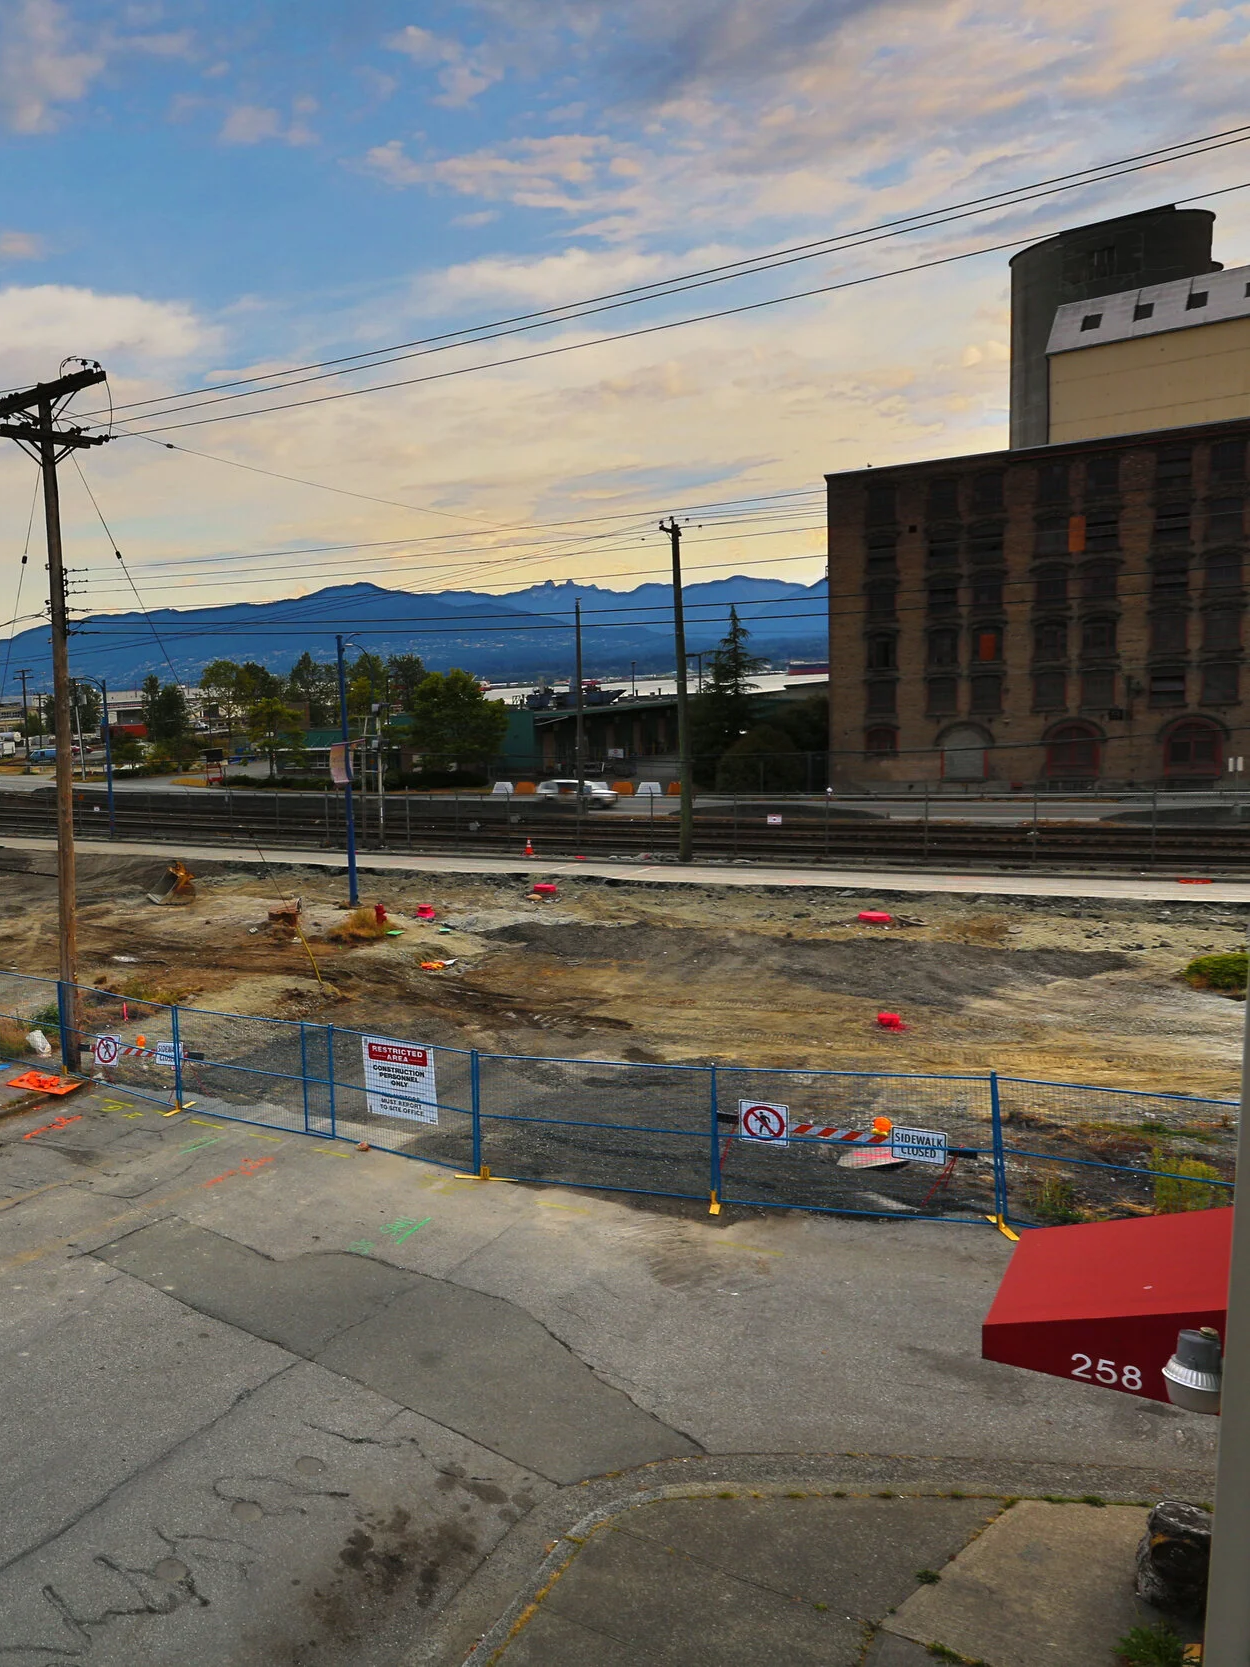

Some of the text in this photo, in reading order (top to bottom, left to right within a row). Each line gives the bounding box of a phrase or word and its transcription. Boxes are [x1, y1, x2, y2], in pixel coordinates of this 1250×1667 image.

[371, 1045, 423, 1058] RESTRICTED
[386, 1054, 409, 1063] AREA
[372, 1064, 425, 1078] CONSTRUCTION
[379, 1071, 419, 1083] PERSONNEL
[390, 1080, 409, 1088] ONLY
[381, 1097, 422, 1110] MUST REPORT
[389, 1105, 402, 1113] SITE
[402, 1107, 424, 1117] OFFICE
[894, 1132, 944, 1148] SIDEWALK
[900, 1146, 937, 1159] CLOSED
[1071, 1353, 1143, 1391] 258
